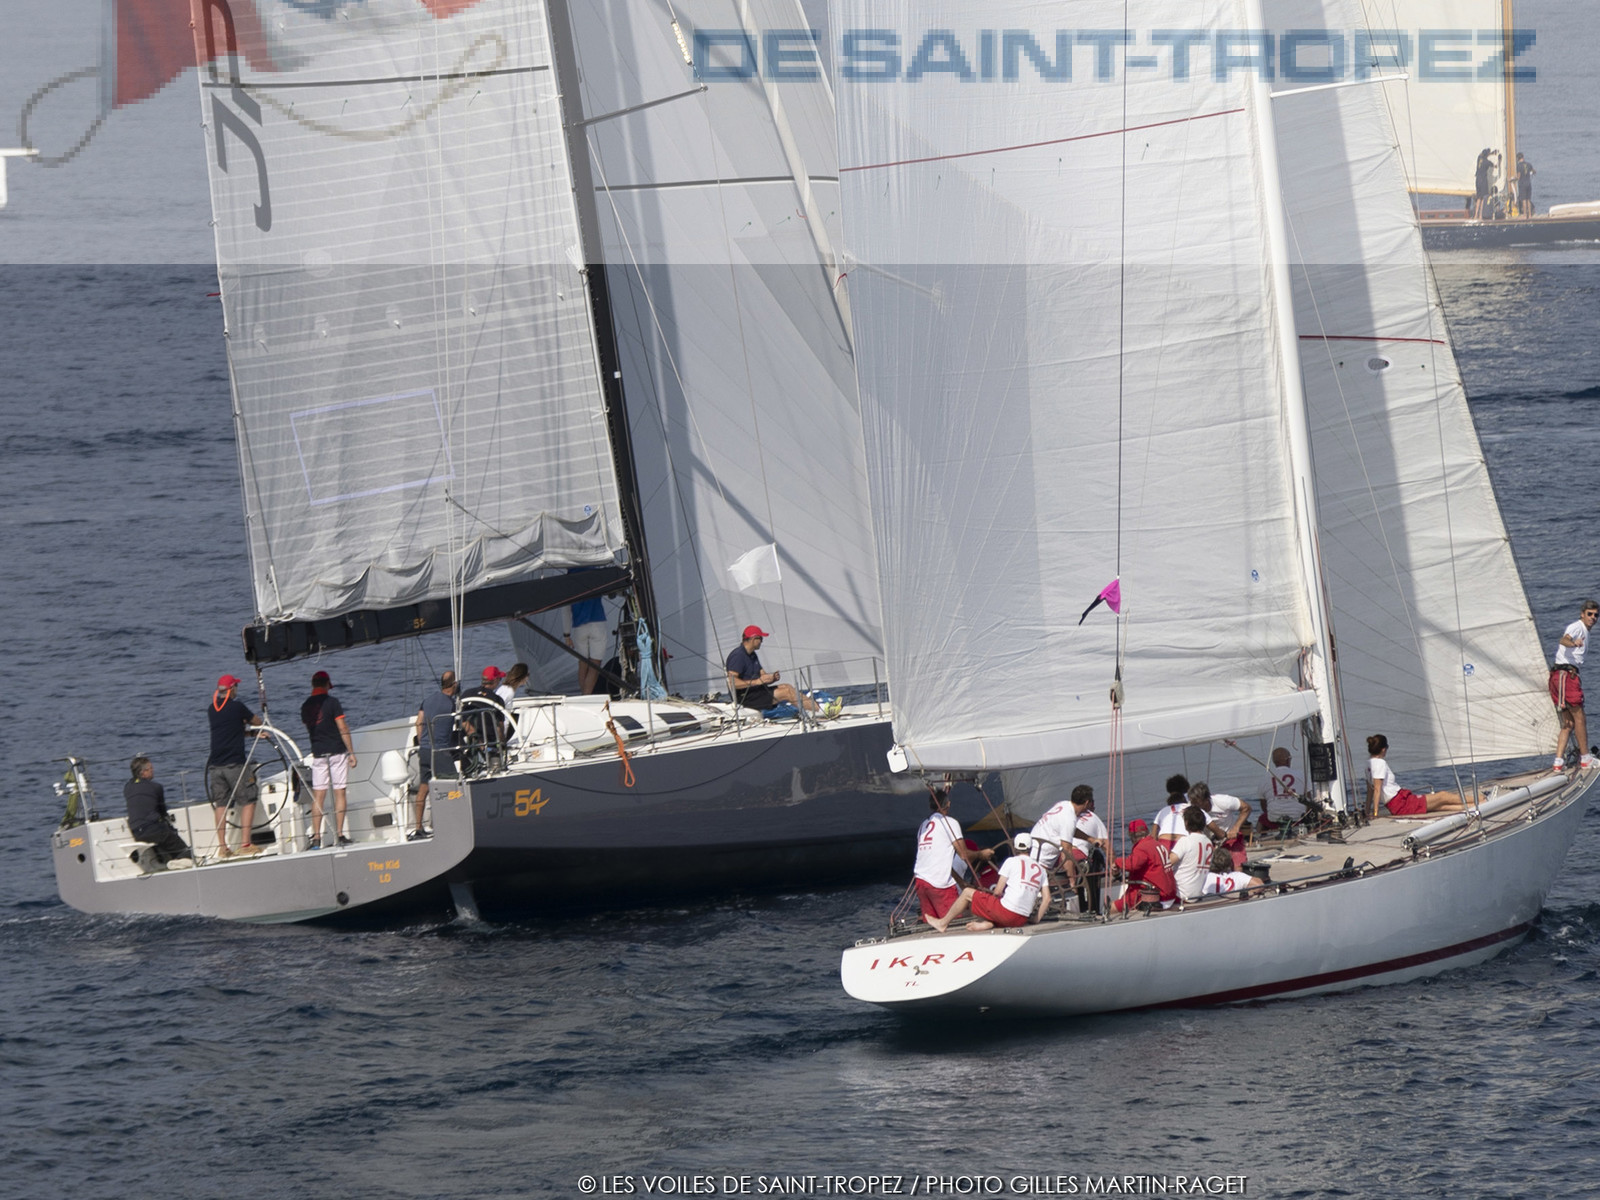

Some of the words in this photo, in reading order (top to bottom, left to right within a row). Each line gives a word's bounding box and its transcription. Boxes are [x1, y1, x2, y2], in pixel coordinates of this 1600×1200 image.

[1197, 842, 1213, 865] 12
[1021, 859, 1042, 885] 12
[870, 951, 974, 970] IKRA
